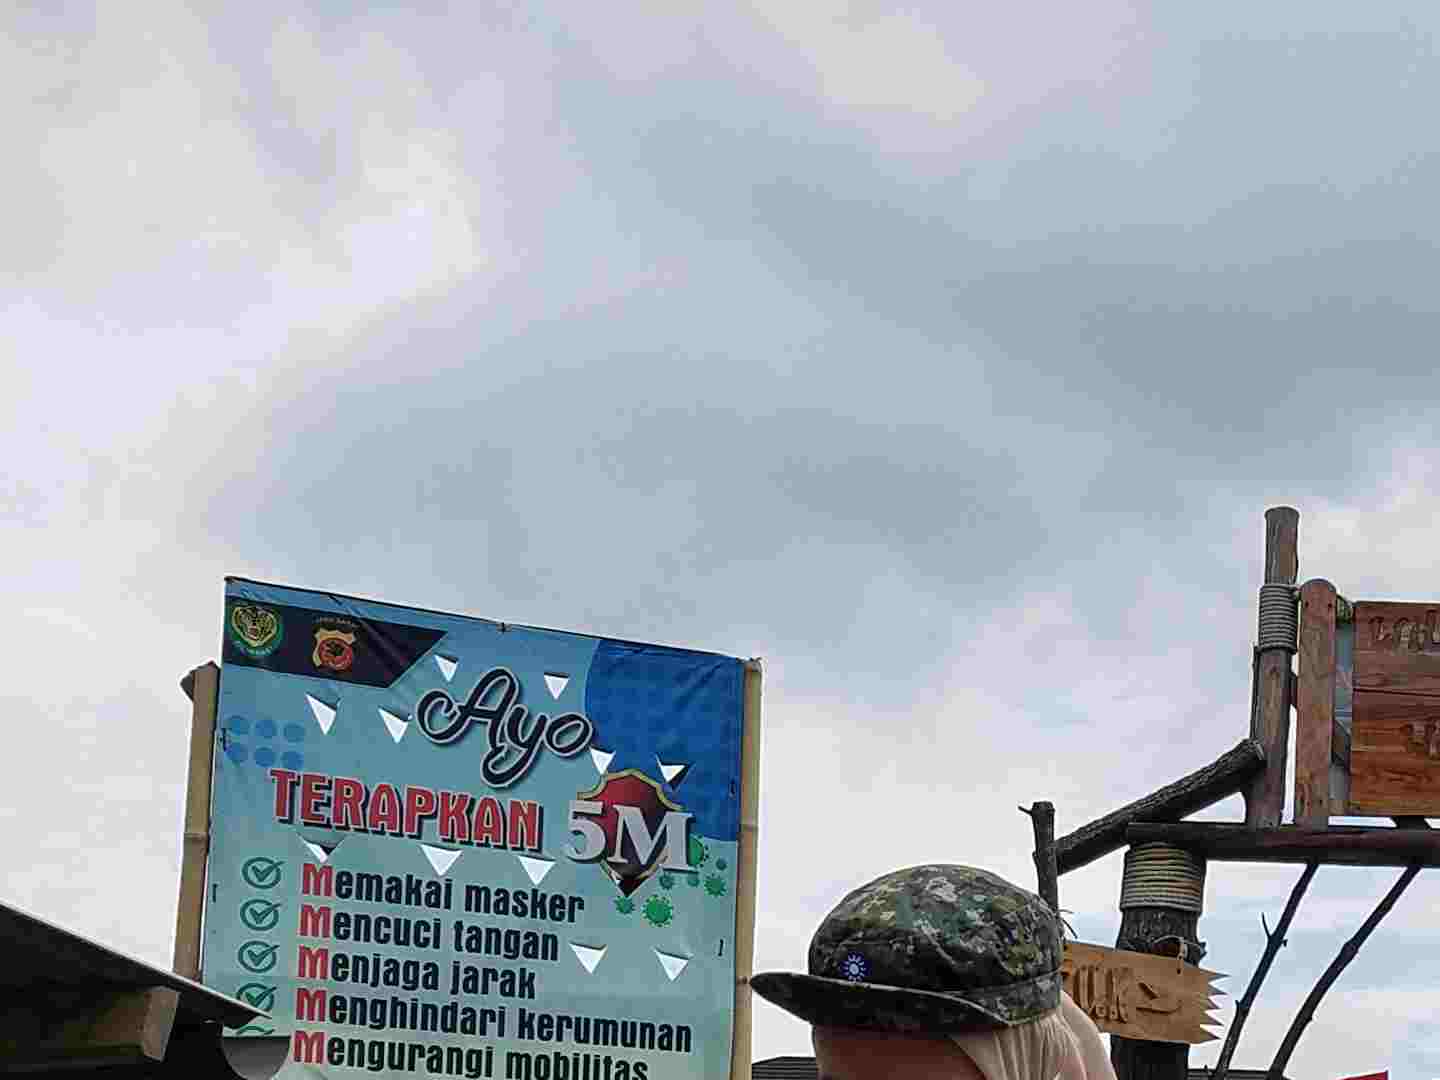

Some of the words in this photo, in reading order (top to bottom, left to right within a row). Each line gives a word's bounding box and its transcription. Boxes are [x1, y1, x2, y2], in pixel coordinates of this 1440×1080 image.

[416, 667, 595, 788] Ayo
[269, 768, 543, 852] TERAPKAN
[566, 801, 695, 872] 5M
[301, 862, 453, 912] Memakai
[464, 878, 585, 924] masker
[298, 904, 442, 949] Mencuci
[454, 920, 560, 962] tangan
[296, 946, 441, 992] Menjaga
[450, 961, 538, 1000] jarak
[295, 989, 506, 1041] Menghindari
[517, 1006, 694, 1054] kerumunan
[292, 1030, 495, 1080] Mengurangi
